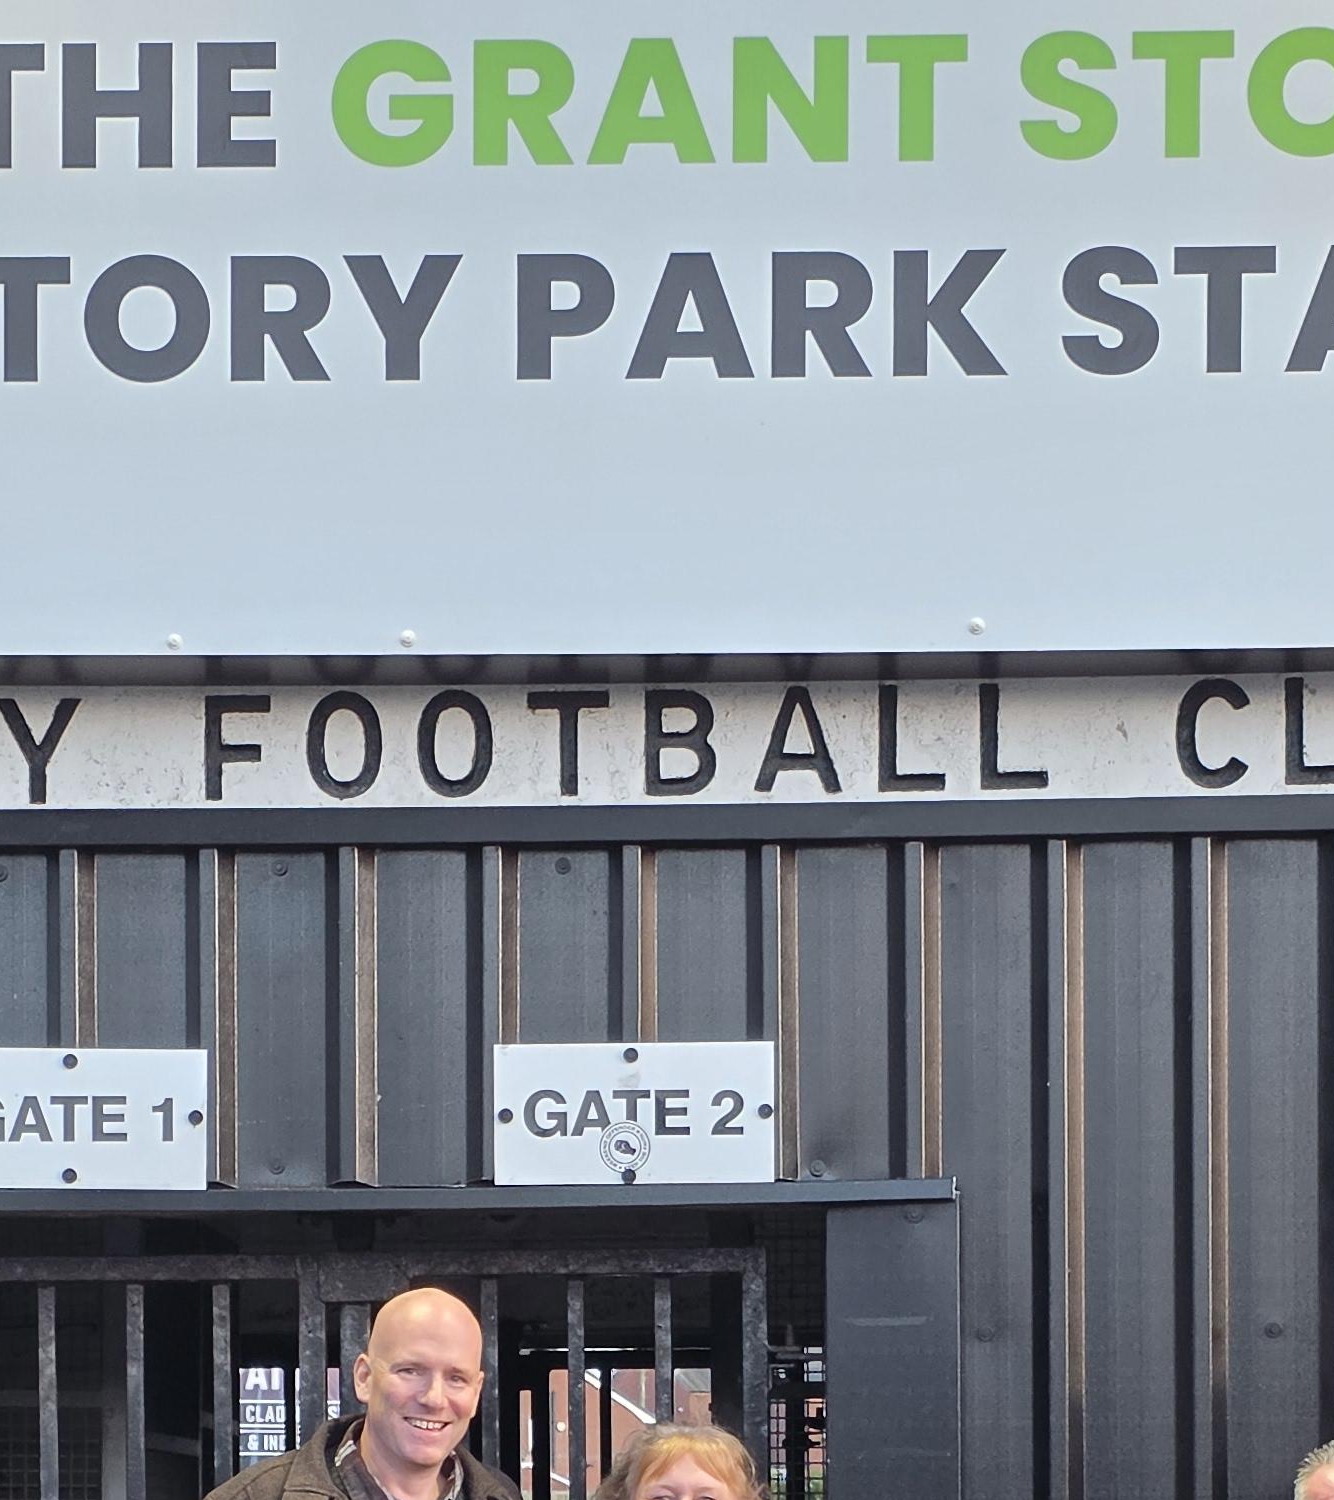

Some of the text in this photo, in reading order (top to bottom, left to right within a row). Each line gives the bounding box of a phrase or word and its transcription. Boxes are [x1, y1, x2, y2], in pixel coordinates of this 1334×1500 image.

[331, 37, 968, 167] GRANT
[516, 249, 1008, 380] PARK
[204, 683, 1049, 802] FOOTBALL
[151, 1097, 175, 1142] 1
[523, 1089, 744, 1138] GATE 2
[245, 1405, 286, 1423] CLAD
